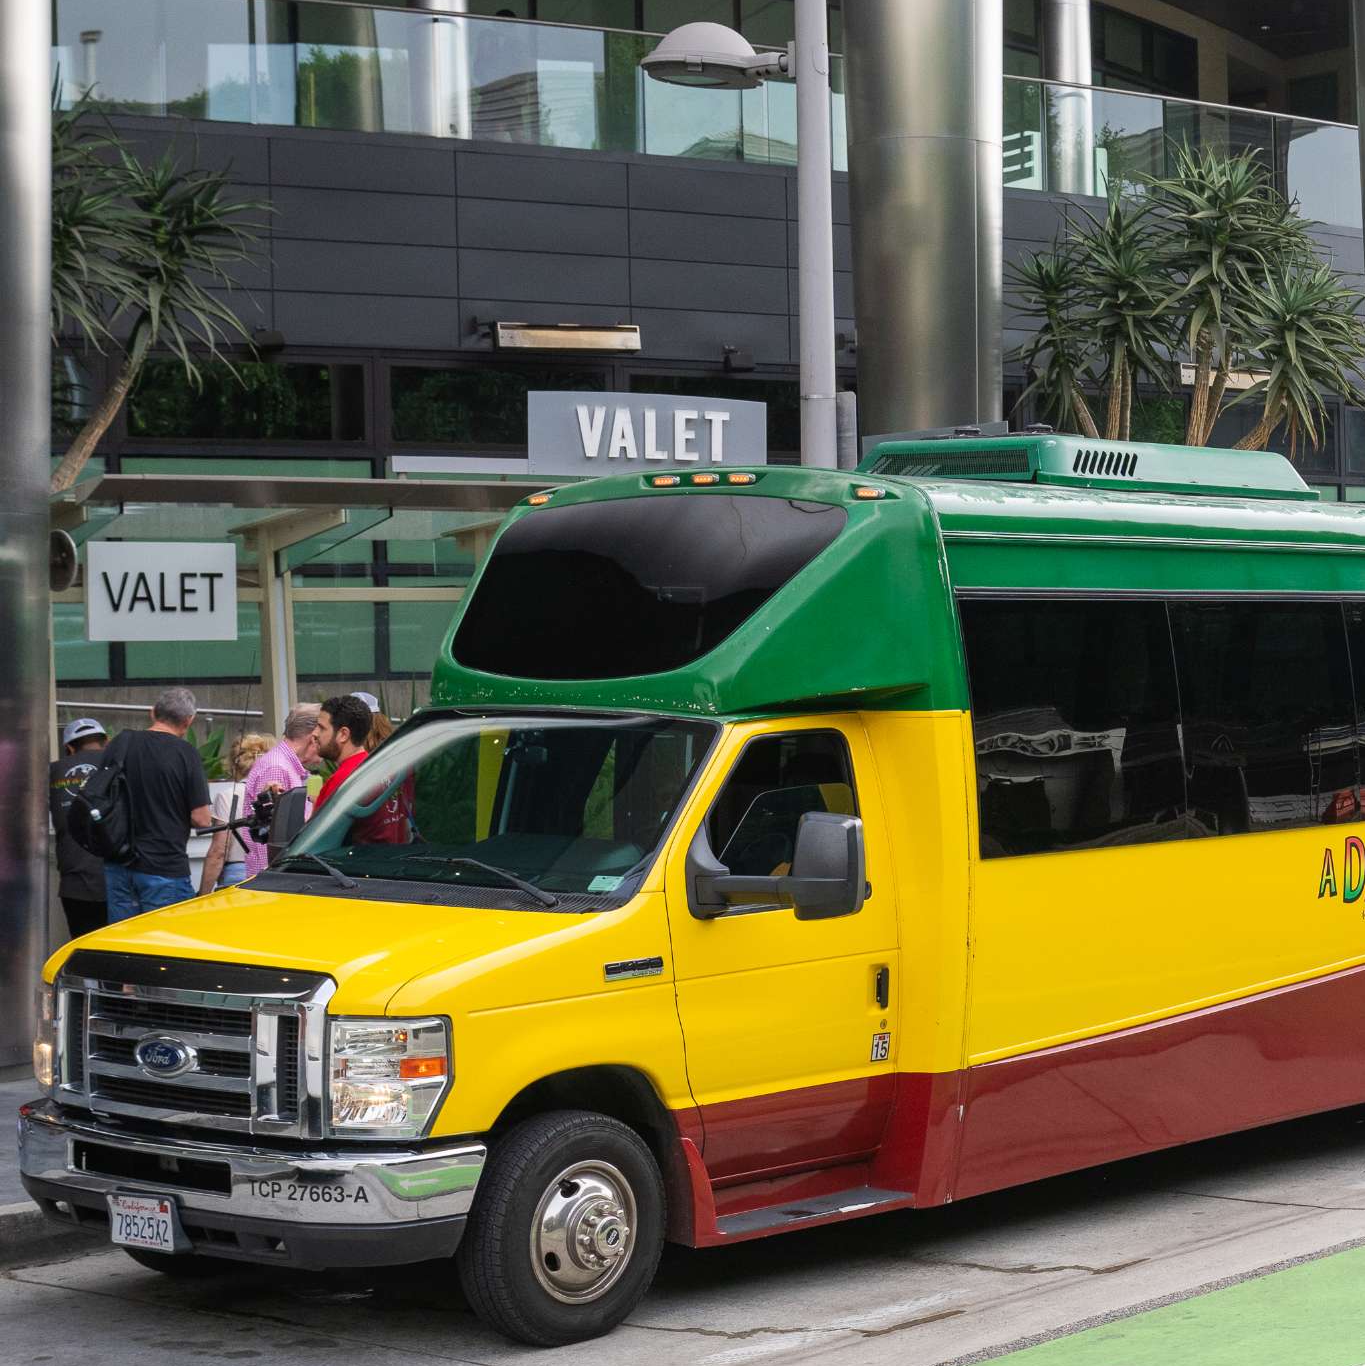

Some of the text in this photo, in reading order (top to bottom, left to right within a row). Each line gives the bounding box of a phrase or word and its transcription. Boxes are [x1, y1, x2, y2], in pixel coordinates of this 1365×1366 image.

[576, 404, 730, 462] VALET
[102, 571, 223, 613] VALET
[1318, 848, 1338, 899] A
[144, 1046, 172, 1065] Ford
[874, 1040, 888, 1058] 15
[248, 1179, 369, 1203] TCP 27663-A
